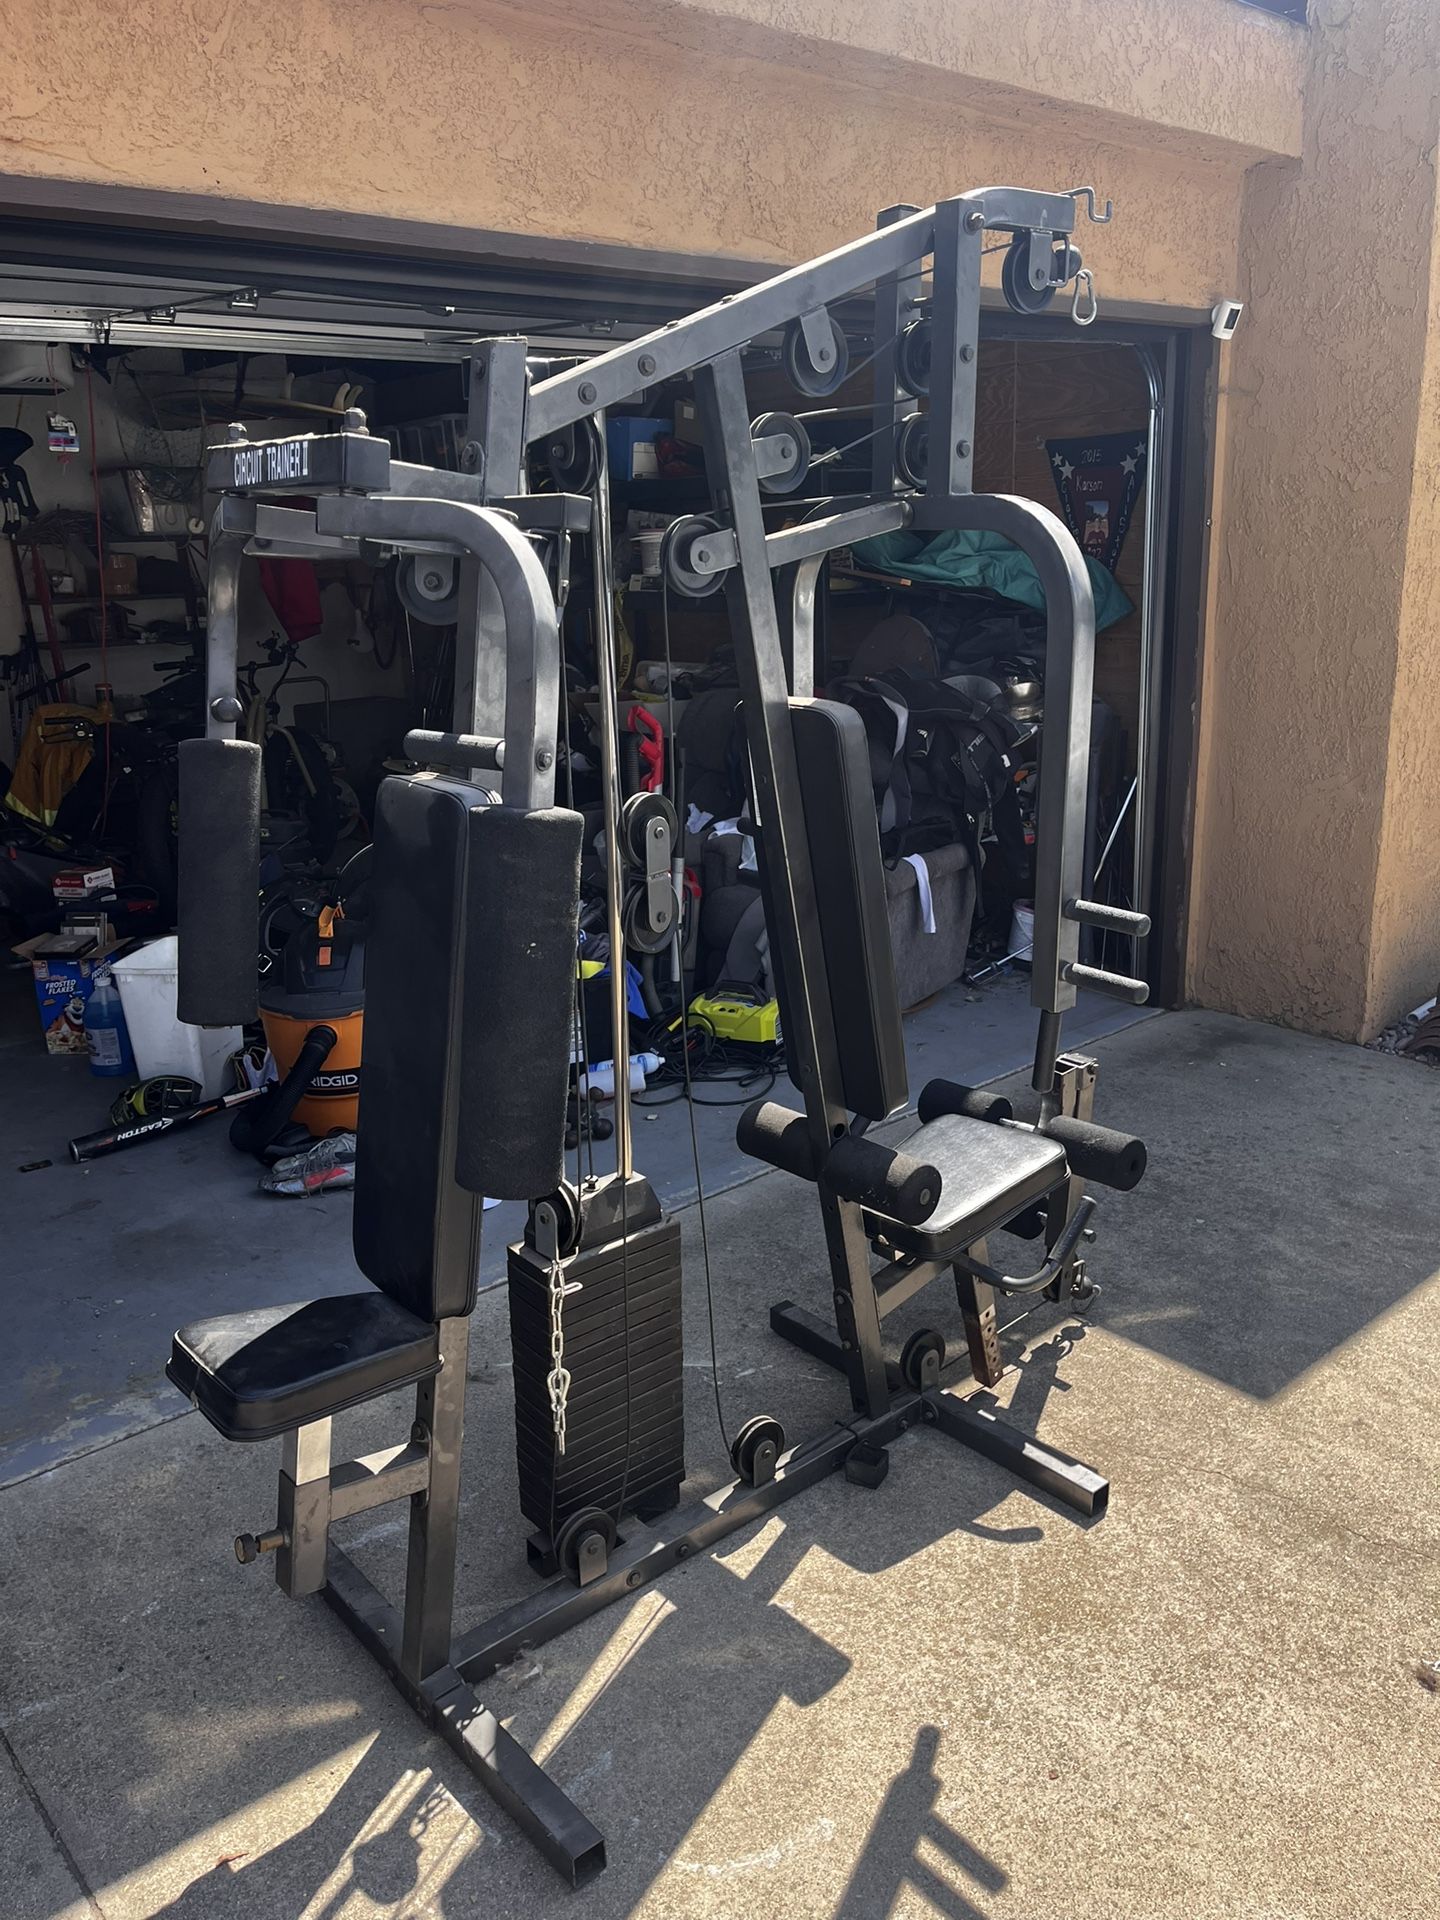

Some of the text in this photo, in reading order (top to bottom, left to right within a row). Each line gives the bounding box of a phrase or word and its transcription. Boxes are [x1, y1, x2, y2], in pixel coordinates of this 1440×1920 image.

[233, 448, 263, 487] CIRCUIT
[266, 441, 301, 481] TRAINER
[45, 979, 77, 990] FROSTED
[48, 986, 74, 995] FLAKES
[117, 1120, 163, 1141] EASTON
